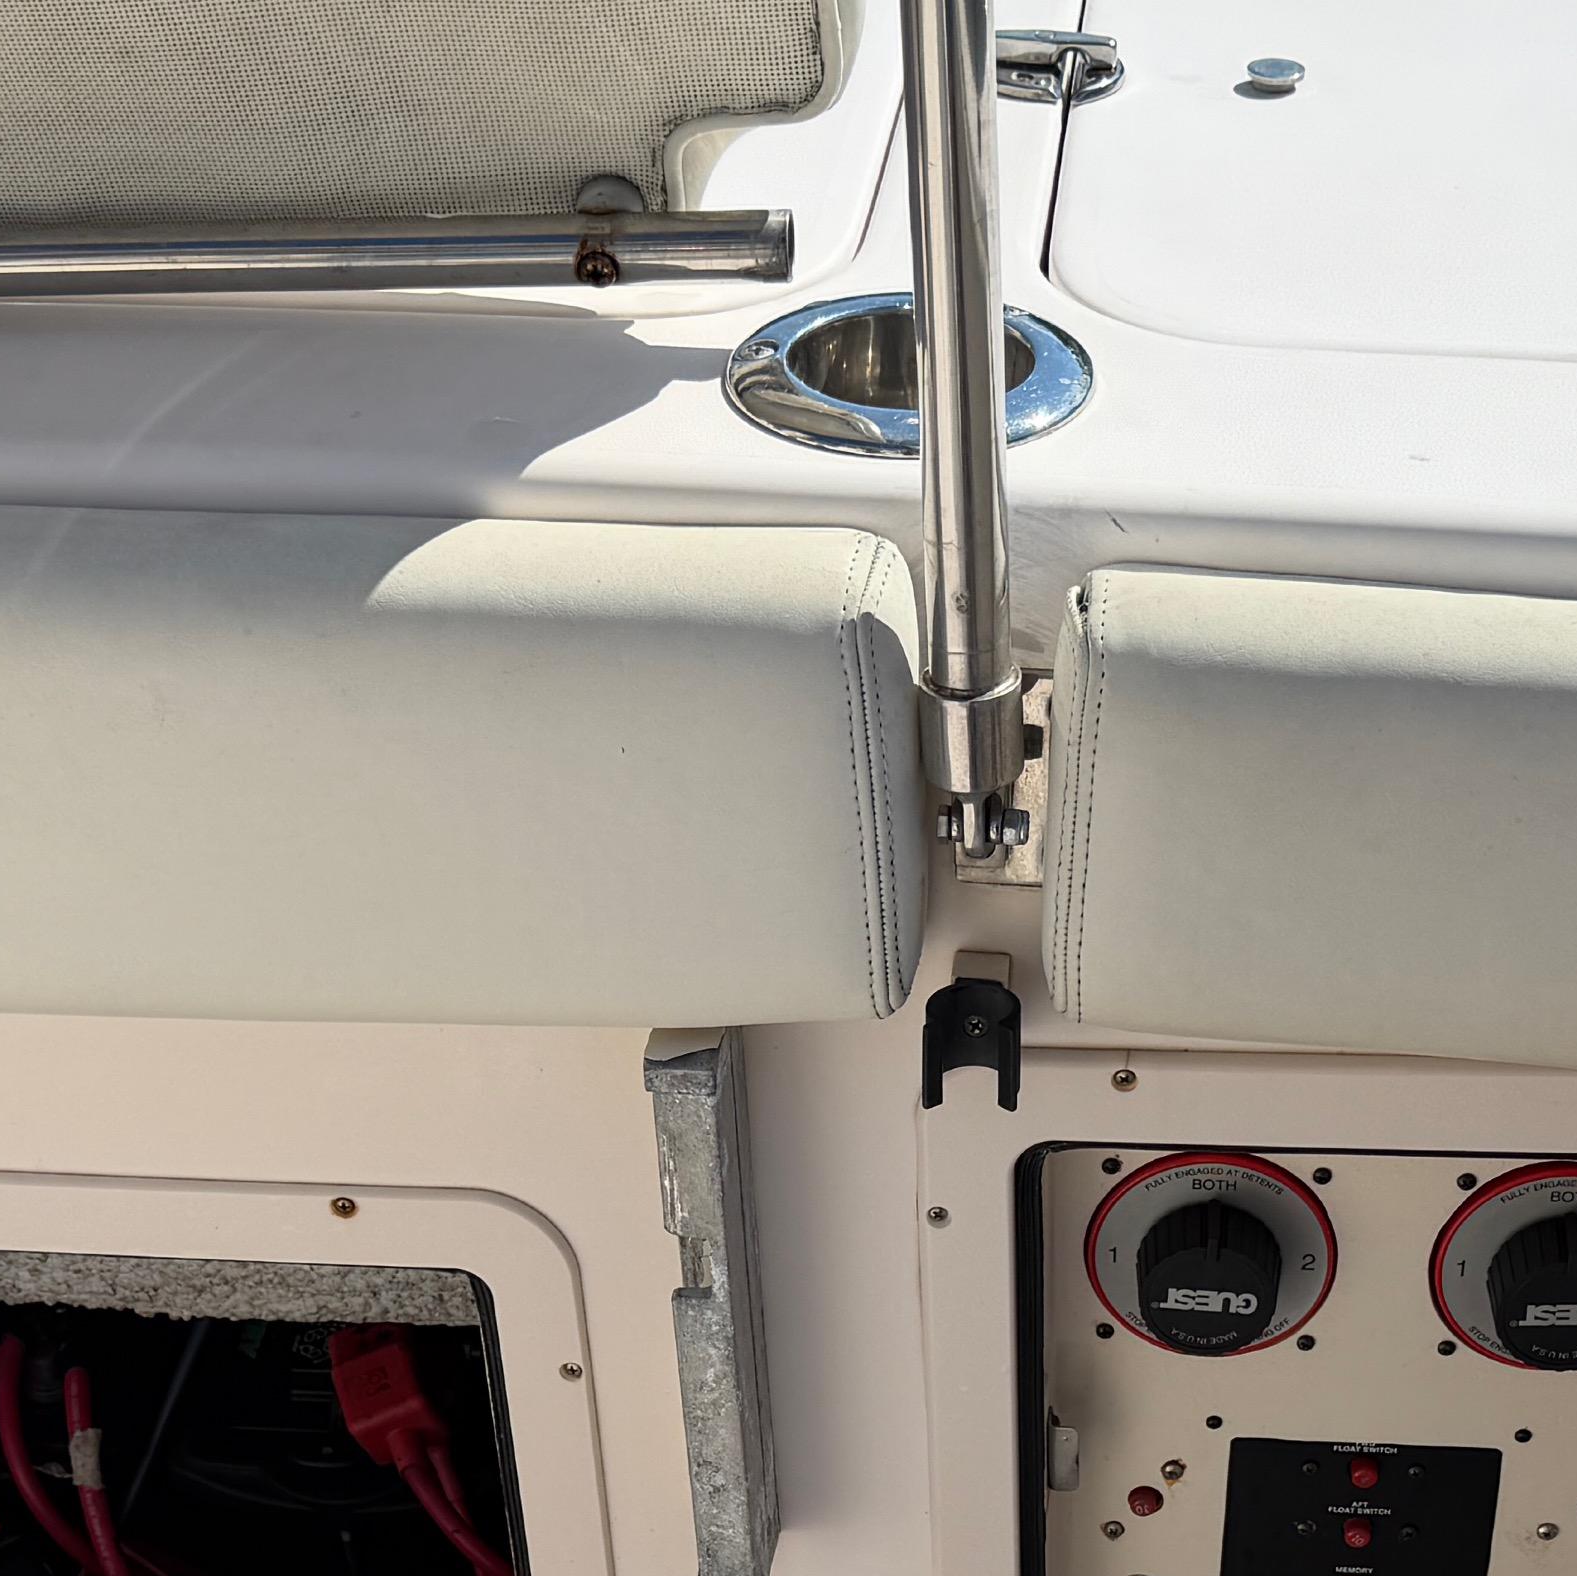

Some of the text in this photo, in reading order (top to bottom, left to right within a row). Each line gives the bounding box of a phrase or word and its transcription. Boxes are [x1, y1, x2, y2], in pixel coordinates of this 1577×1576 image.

[1144, 1167, 1285, 1196] FULLY ENGAGED AT DETENTS
[1192, 1178, 1238, 1191] BOTH
[1500, 1185, 1530, 1204] FULLY
[1108, 1246, 1118, 1263] 1
[1300, 1253, 1317, 1271] 2
[1456, 1259, 1466, 1277] 1
[1159, 1288, 1258, 1315] GUEST
[1333, 1445, 1398, 1454] FLOAT SWITCH
[1327, 1506, 1392, 1516] FLOAT SWITCH
[1335, 1566, 1374, 1574] MEMORY
